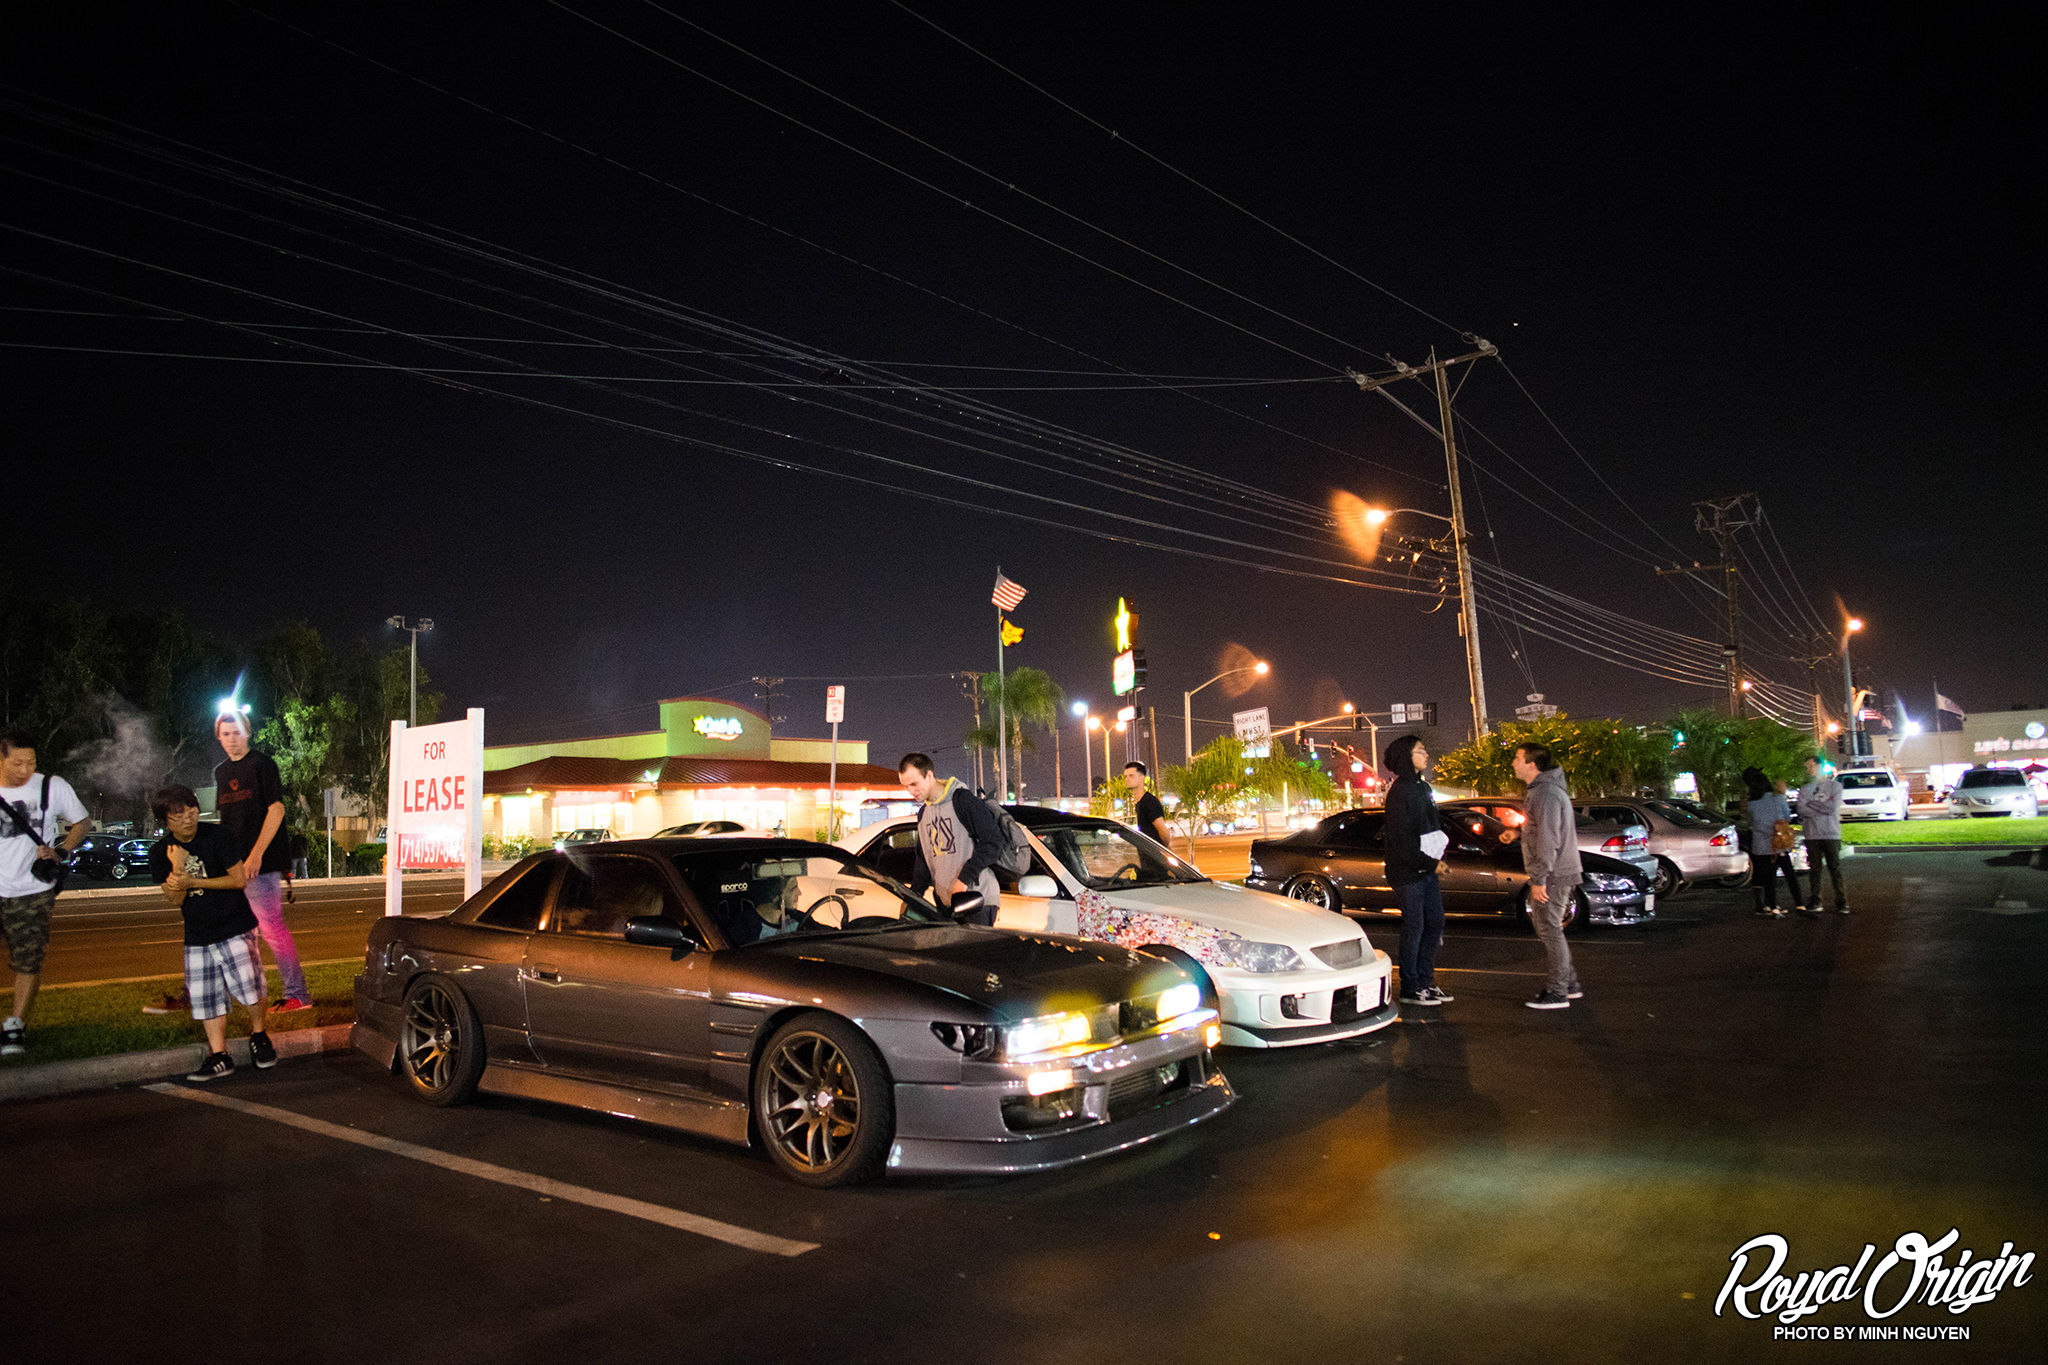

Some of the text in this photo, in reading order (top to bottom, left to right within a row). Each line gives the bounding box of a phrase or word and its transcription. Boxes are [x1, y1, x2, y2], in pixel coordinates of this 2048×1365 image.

[1237, 713, 1266, 724] RIGHT LANE
[424, 741, 446, 760] FOR
[403, 775, 465, 813] LEASE
